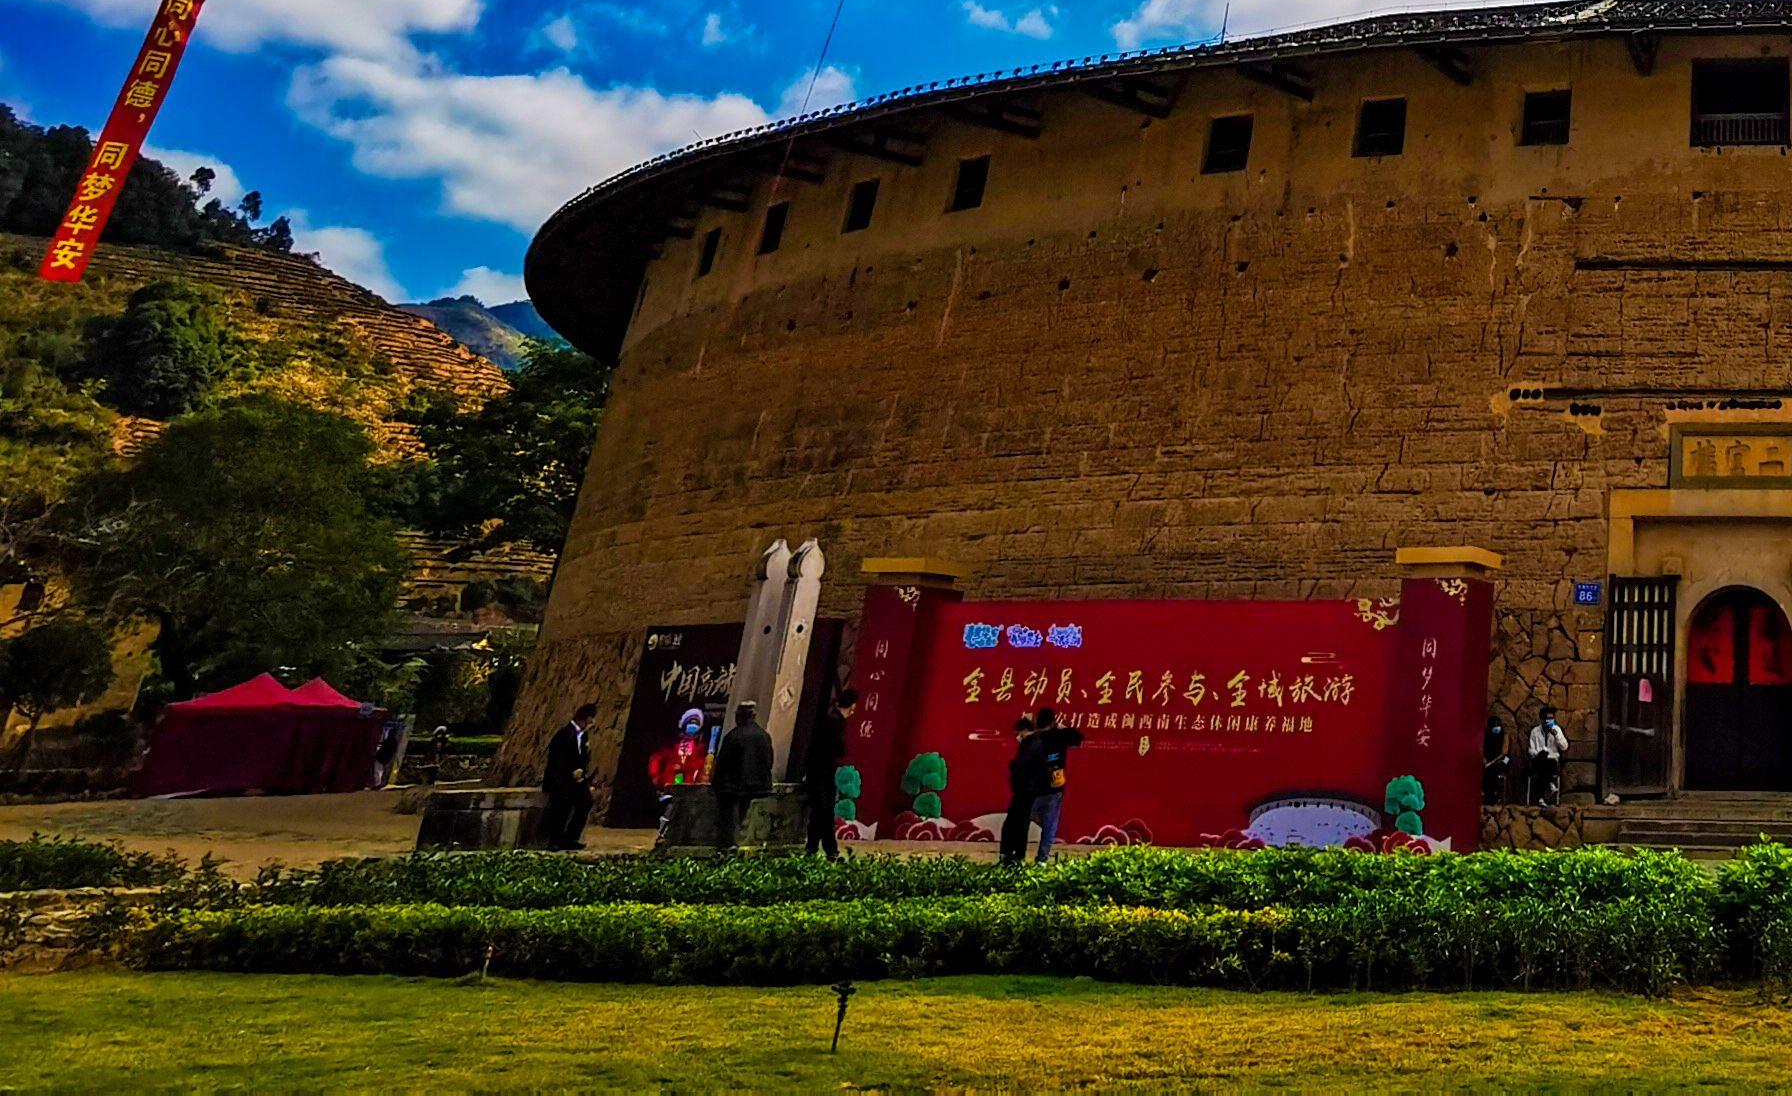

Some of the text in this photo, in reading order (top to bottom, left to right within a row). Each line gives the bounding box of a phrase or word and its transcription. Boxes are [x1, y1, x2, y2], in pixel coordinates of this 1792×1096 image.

[1579, 590, 1593, 602] 86
[1021, 711, 1314, 733] 安打造成闽西南生态休闲康养福地
